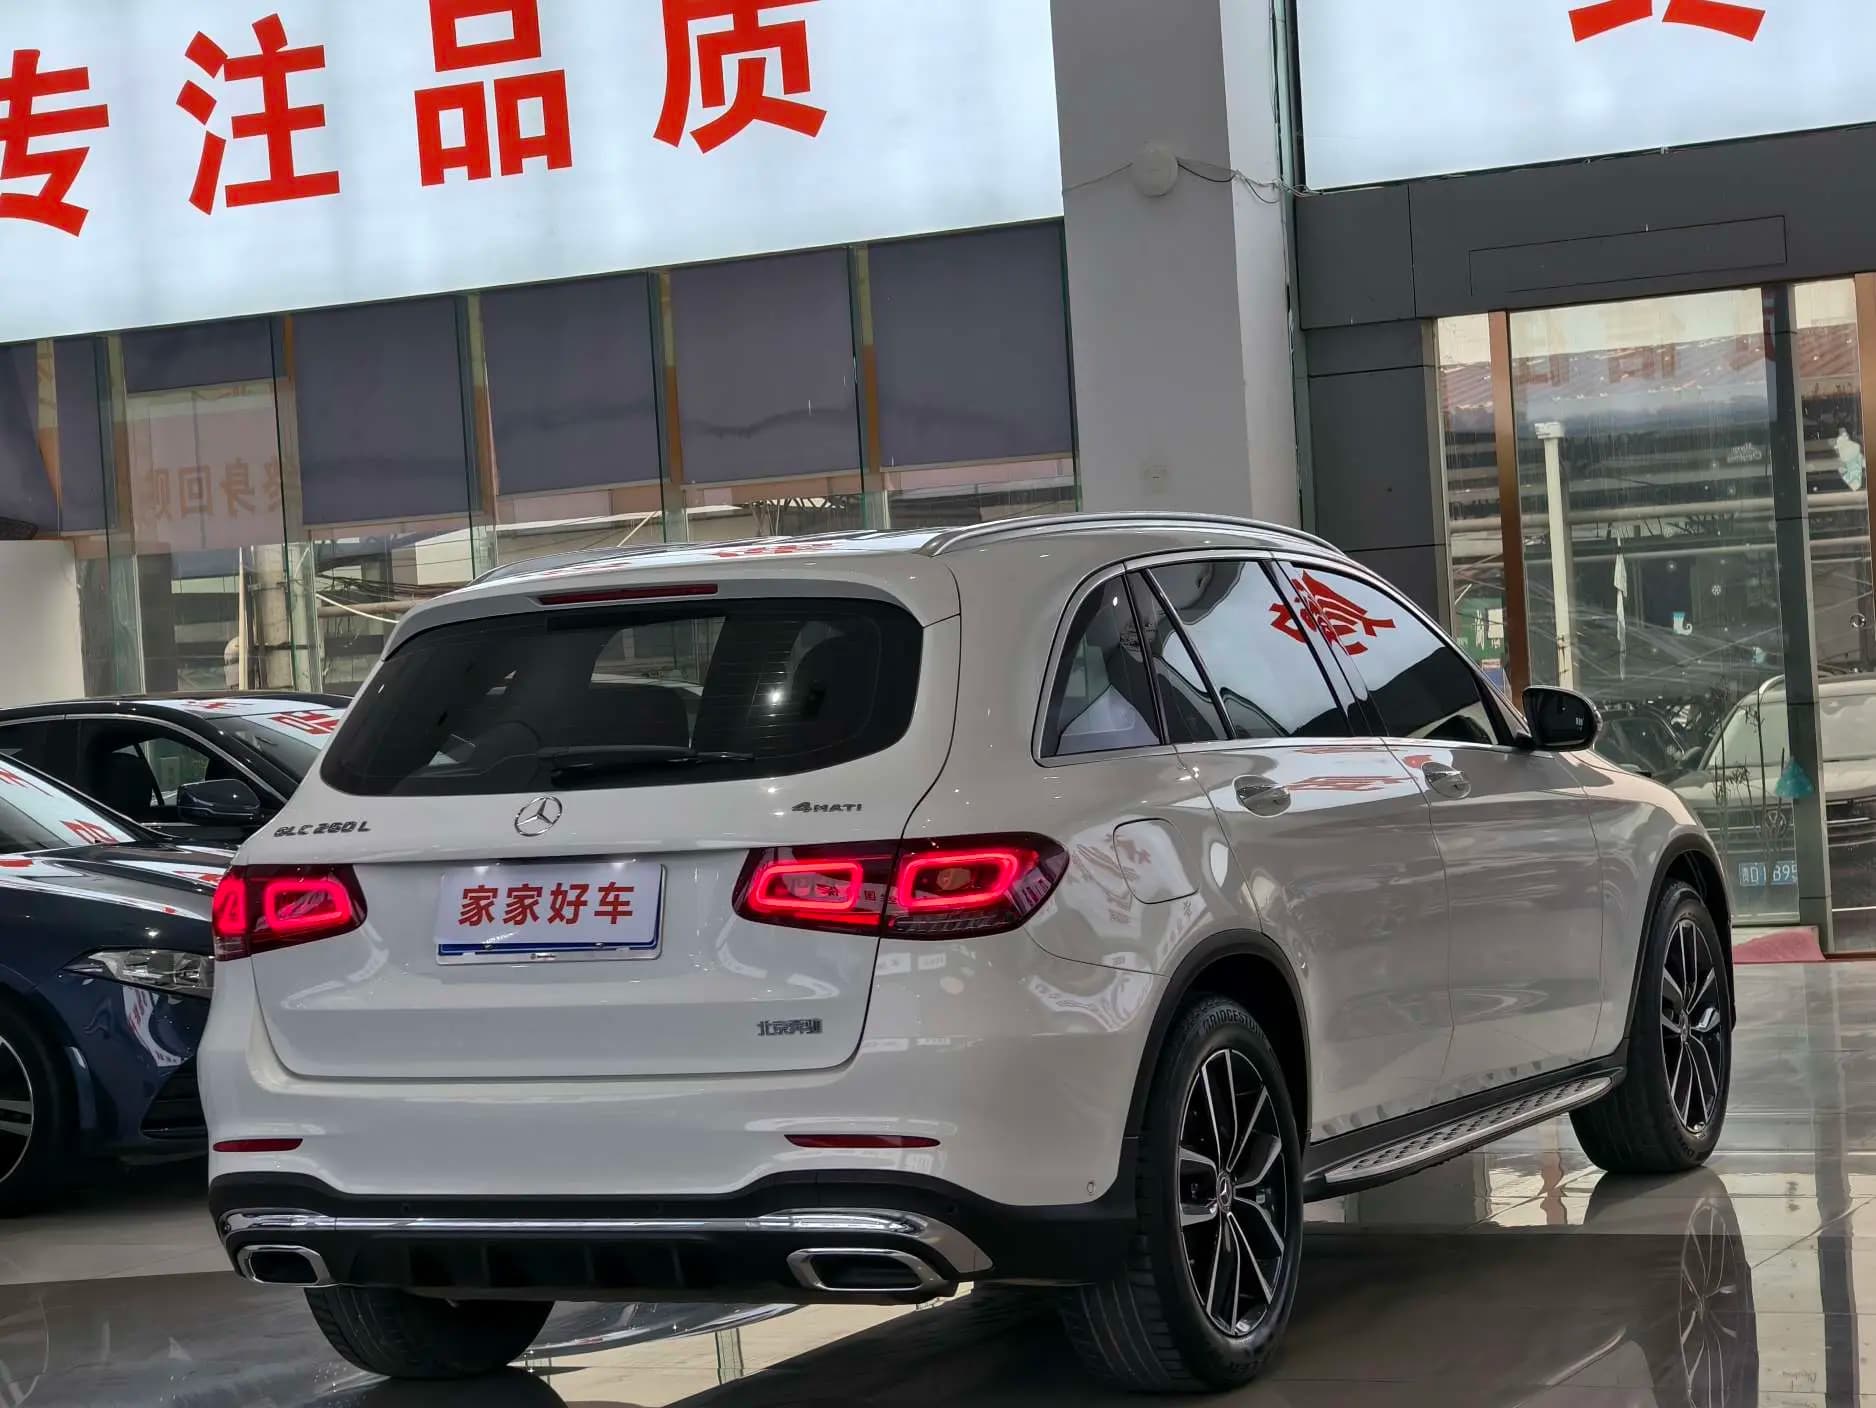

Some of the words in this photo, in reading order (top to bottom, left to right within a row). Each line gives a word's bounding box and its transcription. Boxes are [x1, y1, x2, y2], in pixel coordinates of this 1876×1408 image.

[0, 0, 826, 235] 专注品质
[273, 824, 314, 837] GLC
[458, 881, 635, 926] 家家好车
